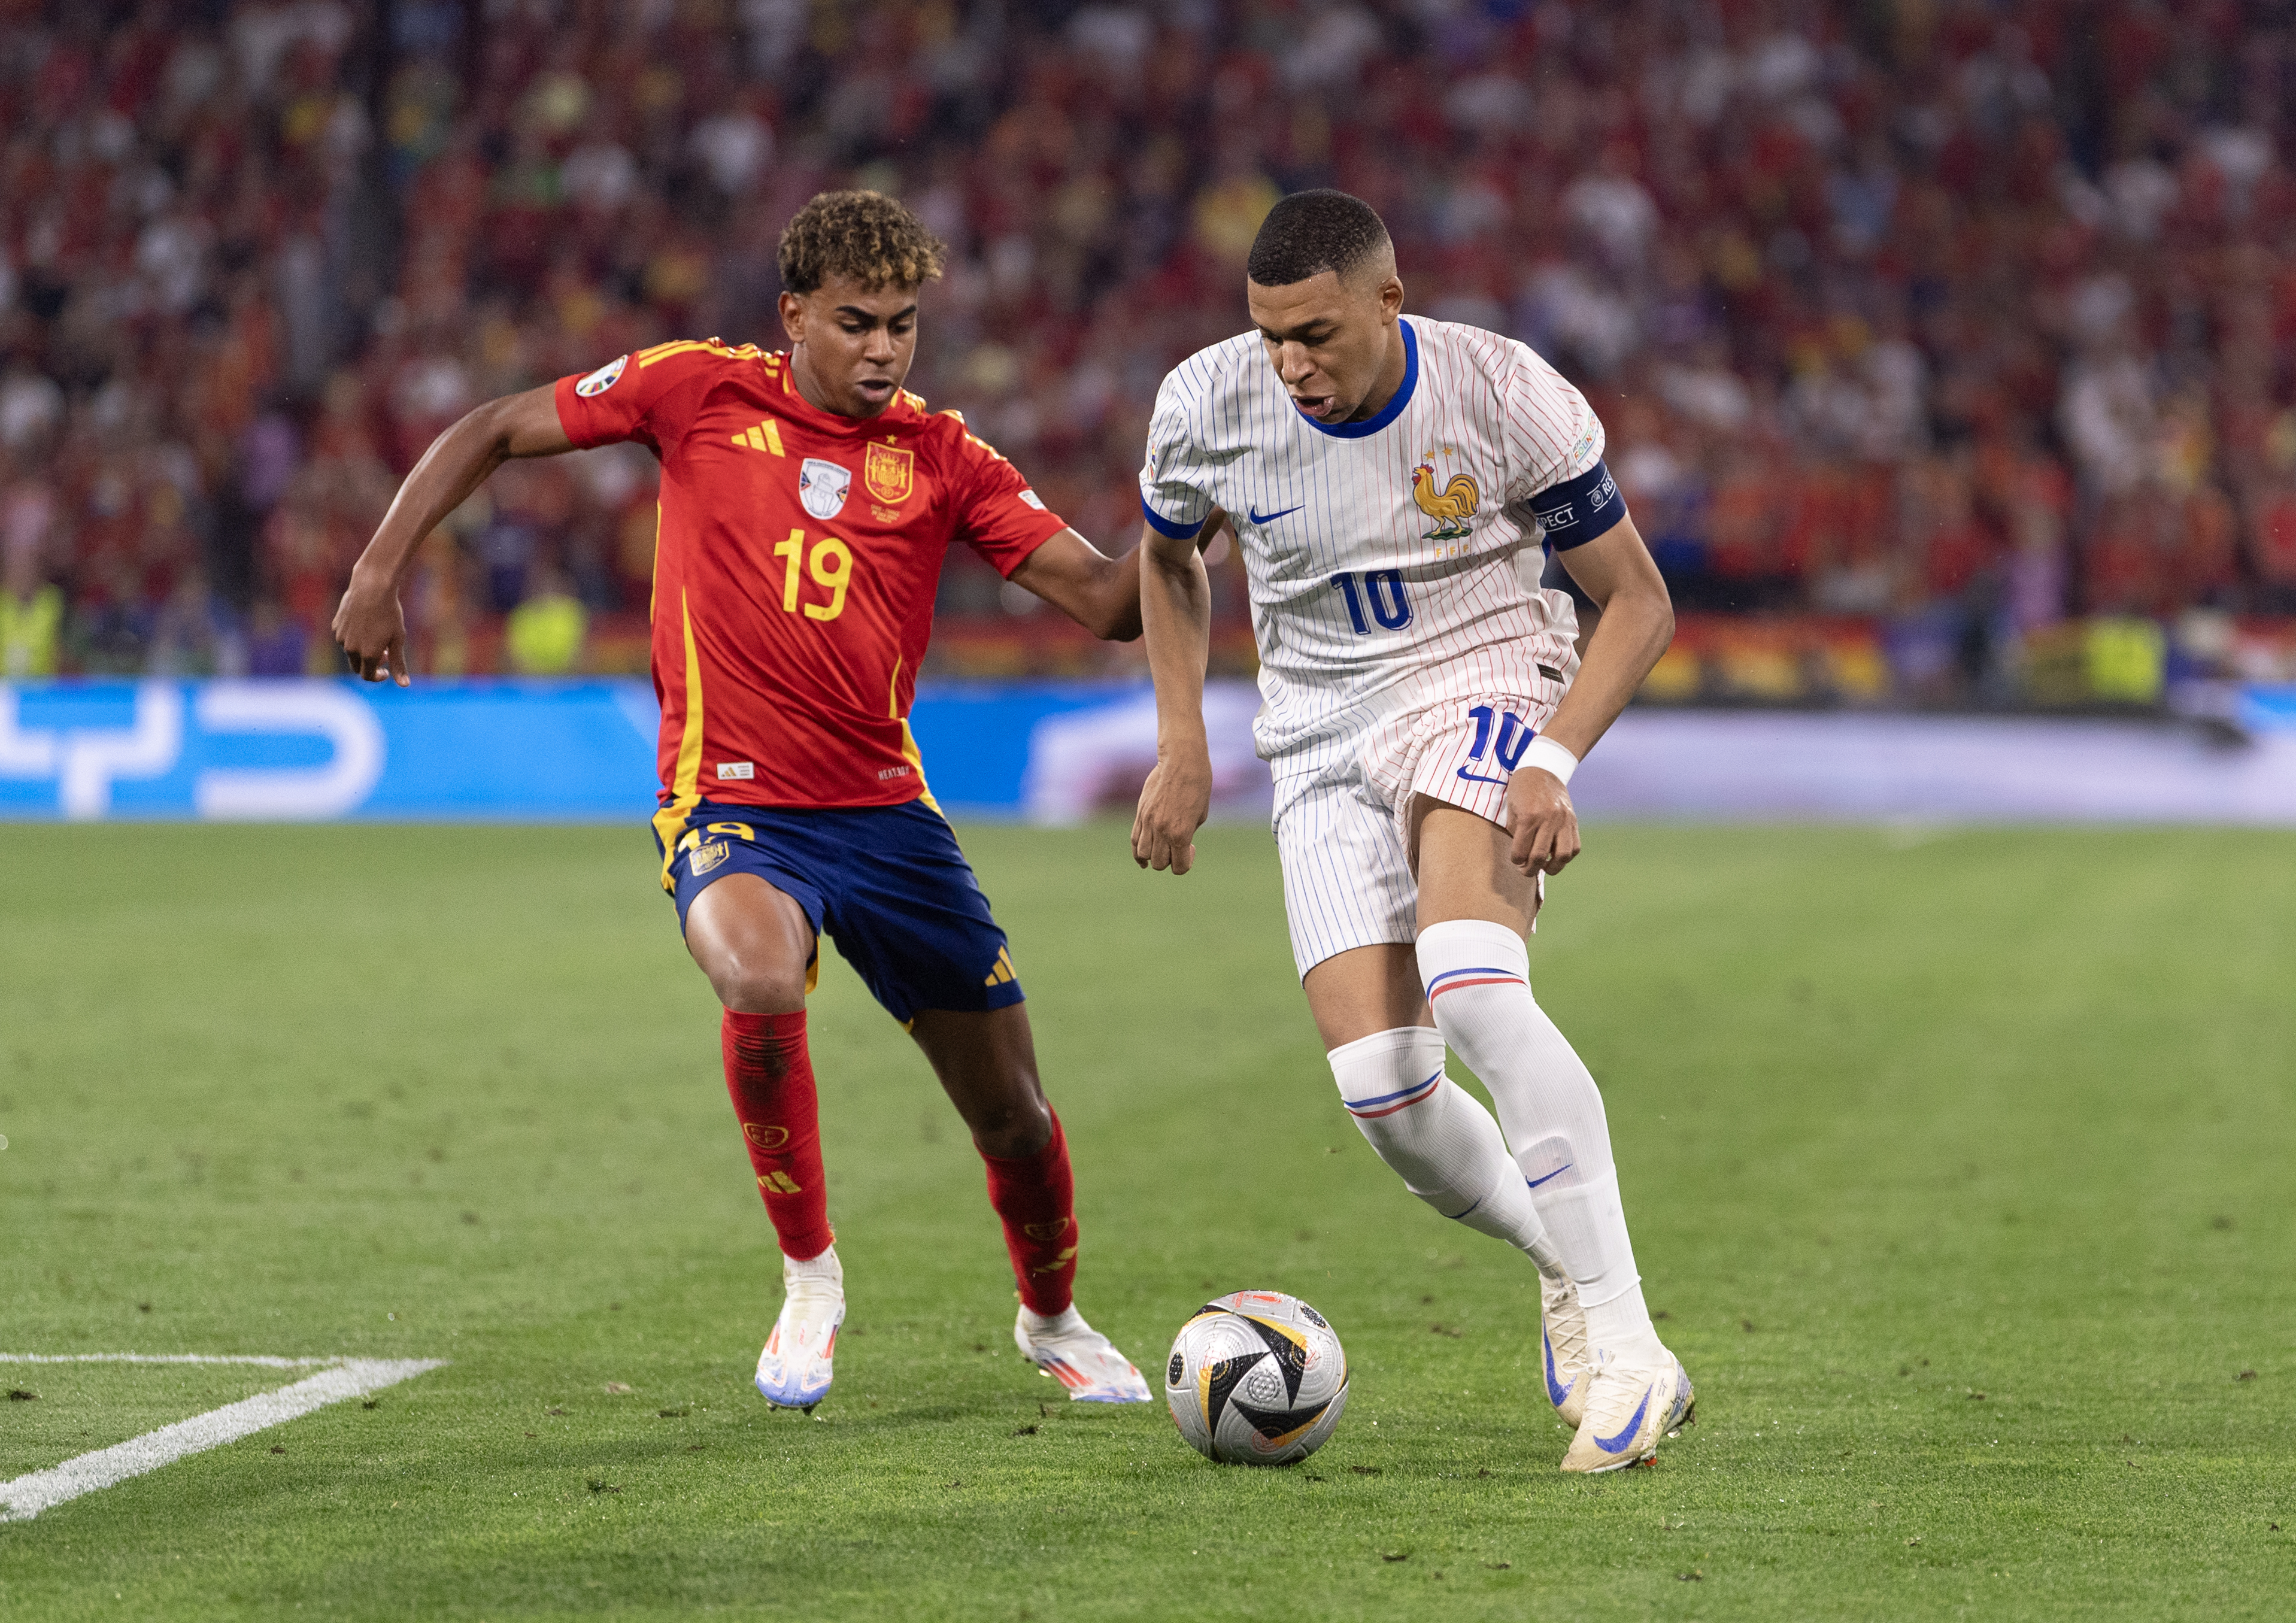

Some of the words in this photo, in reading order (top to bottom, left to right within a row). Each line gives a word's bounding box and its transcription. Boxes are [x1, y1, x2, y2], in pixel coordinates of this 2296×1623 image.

[774, 528, 853, 621] 19
[1330, 569, 1414, 635] 10
[1469, 705, 1538, 776] 10
